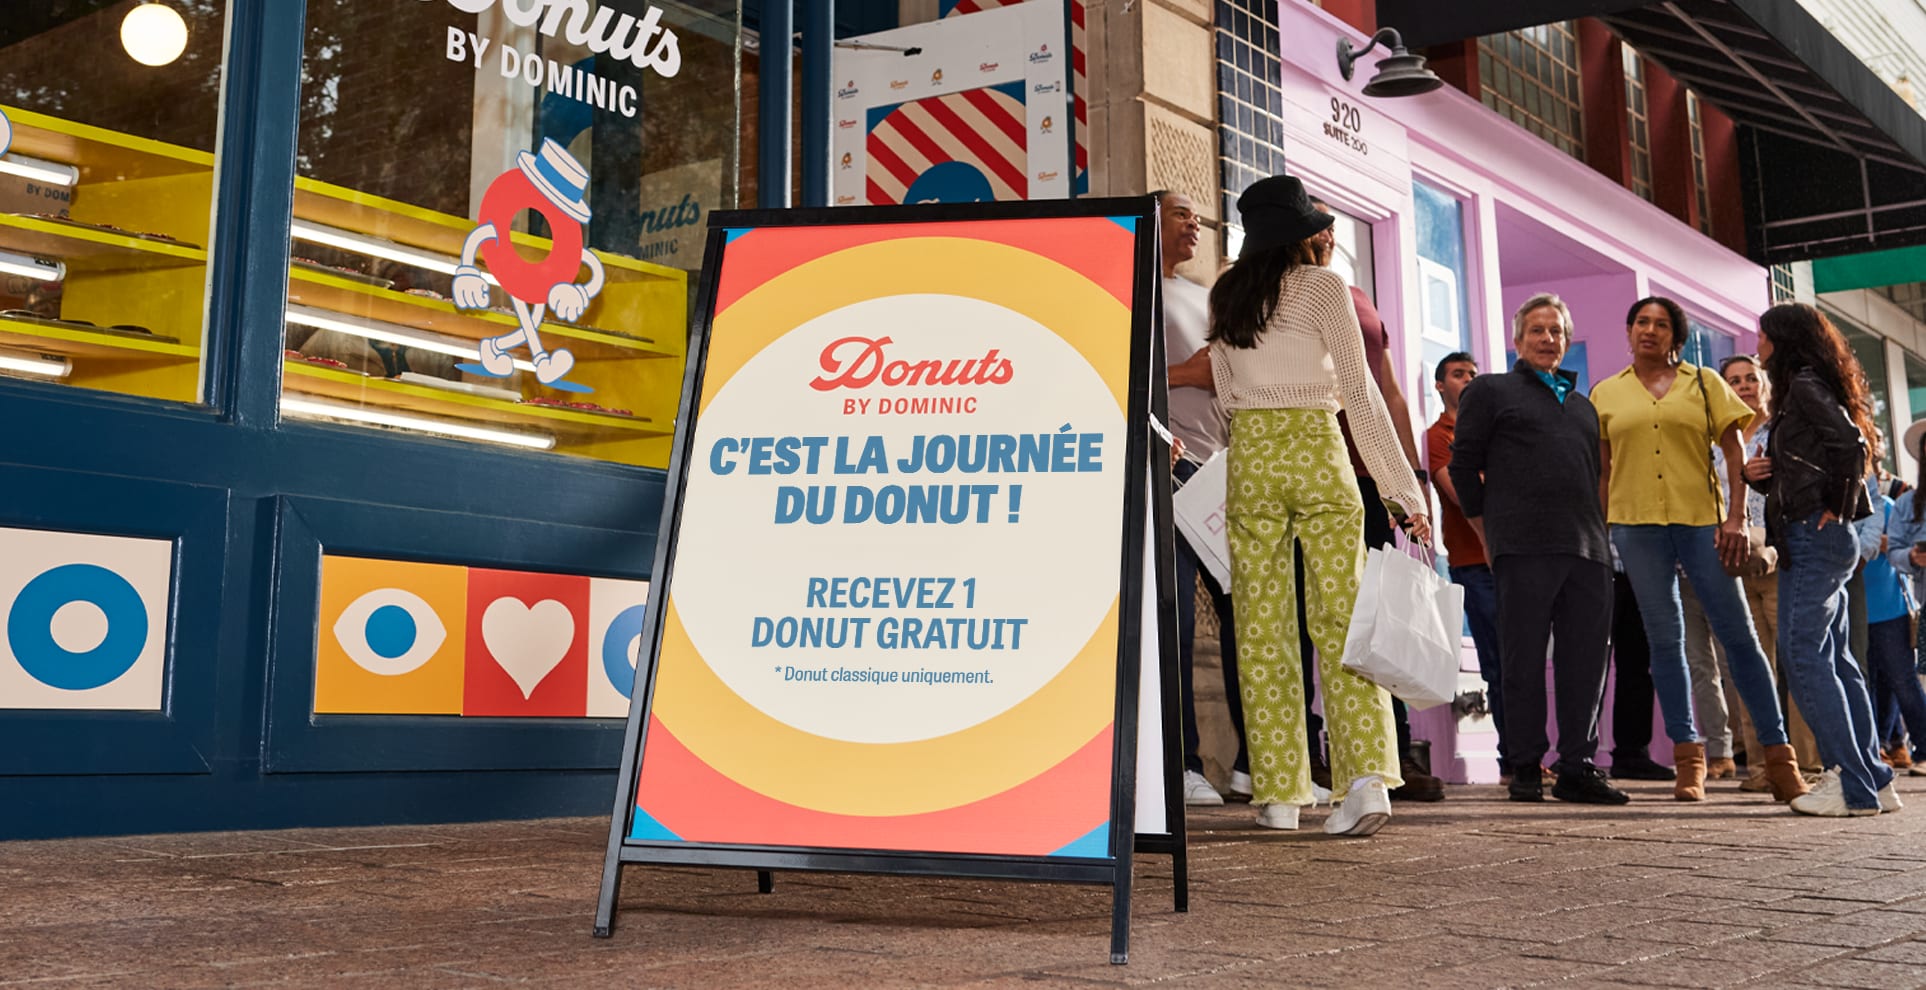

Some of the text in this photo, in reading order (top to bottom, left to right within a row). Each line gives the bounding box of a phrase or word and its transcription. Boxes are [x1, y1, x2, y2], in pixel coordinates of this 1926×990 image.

[419, 0, 682, 77] onuts
[446, 26, 638, 118] BY DOMINIC
[1330, 97, 1361, 133] 920
[1322, 121, 1368, 155] SUITE 200
[26, 183, 41, 196] BY
[639, 193, 700, 234] nuts
[808, 336, 1014, 391] Donuts
[843, 396, 978, 415] BY DOMINIC
[709, 422, 1104, 476] C’EST LA JOURNÉE
[774, 484, 837, 525] DU
[843, 484, 999, 525] DONUT
[806, 576, 976, 608] RECEVEZ 1
[751, 616, 1029, 650] DONUT GRATUIT
[784, 665, 828, 681] Donut
[830, 667, 898, 685] classique
[901, 668, 994, 685] uniquement.
